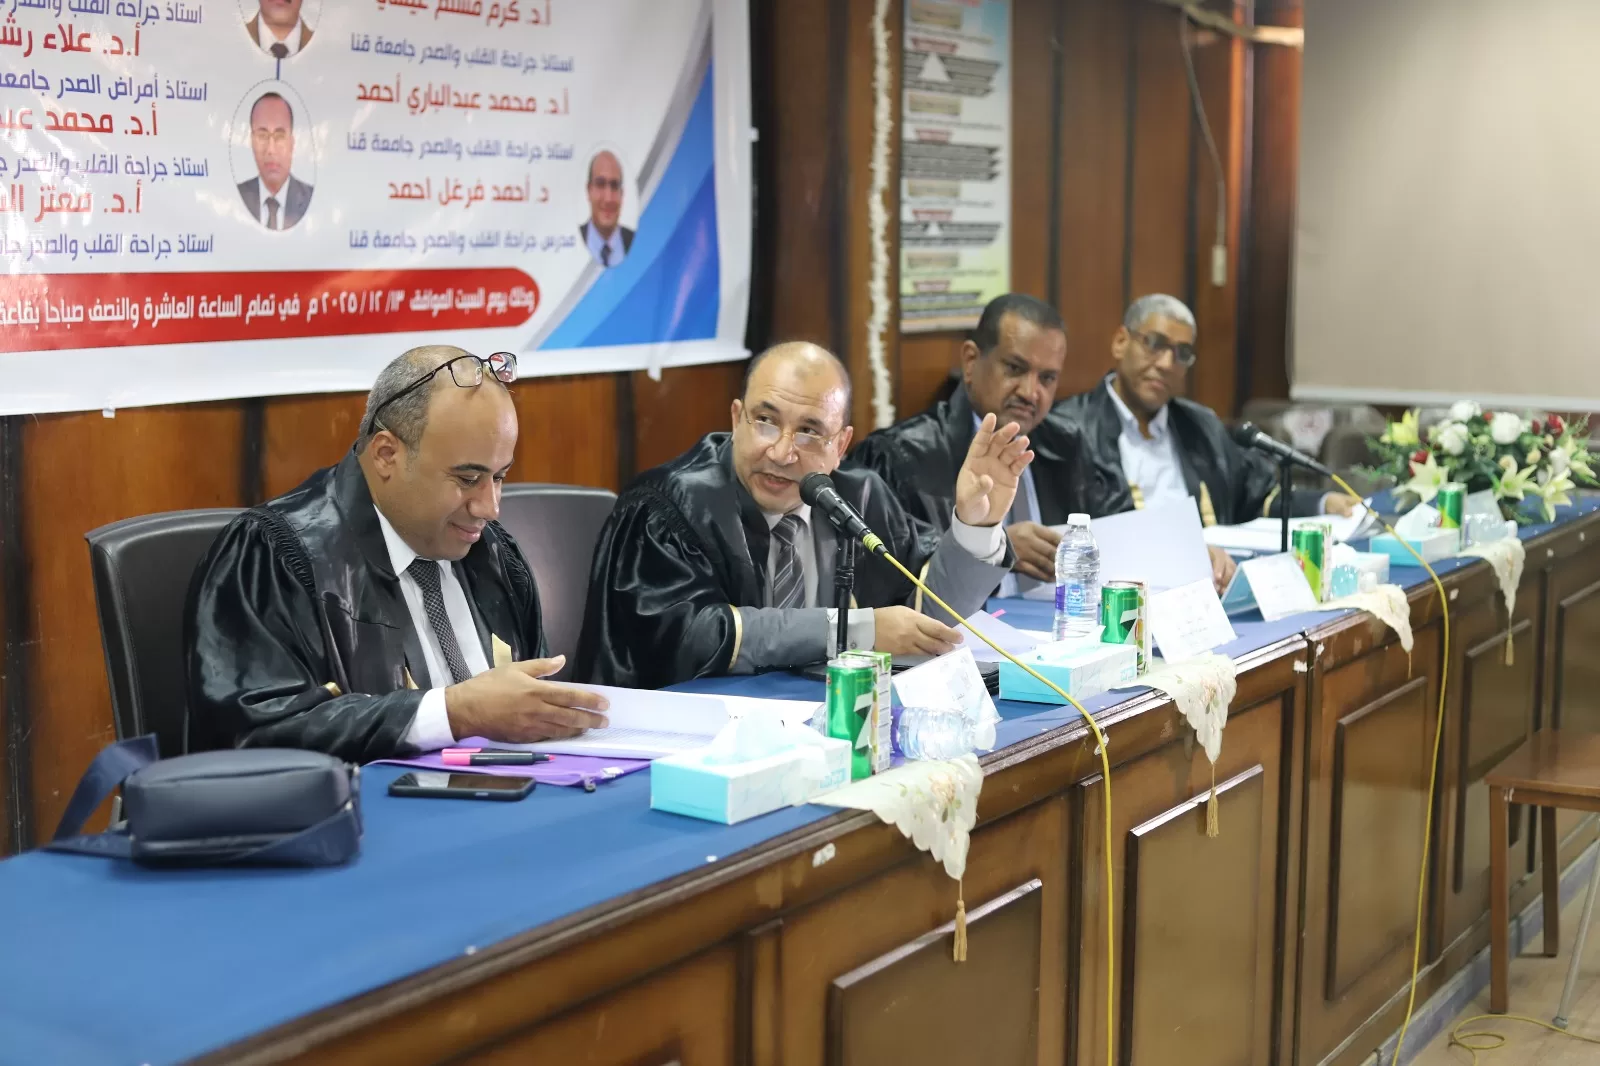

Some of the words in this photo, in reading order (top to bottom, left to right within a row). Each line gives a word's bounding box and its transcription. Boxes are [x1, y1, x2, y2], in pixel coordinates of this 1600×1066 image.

[165, 2, 202, 24] استاذ
[0, 12, 33, 57] رش
[43, 24, 92, 52] علاء
[350, 32, 370, 52] قنا
[374, 35, 416, 62] جامعة
[0, 69, 50, 96] جامع
[57, 74, 101, 99] الصدر
[108, 73, 158, 104] أمراض
[165, 80, 207, 102] استاذ
[489, 92, 537, 113] محمد
[45, 110, 113, 134] محمد
[347, 131, 367, 151] قنا
[371, 133, 413, 156] جامعة
[76, 154, 118, 179] القلب
[124, 155, 168, 182] جراحة
[174, 157, 209, 177] استاذ
[35, 185, 92, 223] معتز
[438, 177, 485, 208] فرغل
[27, 234, 79, 261] والصدر
[84, 234, 123, 259] القلب
[130, 234, 172, 261] جراحة
[177, 234, 214, 253] استاذ
[349, 228, 369, 249] قنا
[373, 229, 416, 253] جامعة
[88, 297, 140, 329] والنصف
[144, 292, 195, 329] العاشرة
[198, 294, 242, 319] الساعة
[245, 293, 275, 325] تمام
[278, 293, 300, 322] في
